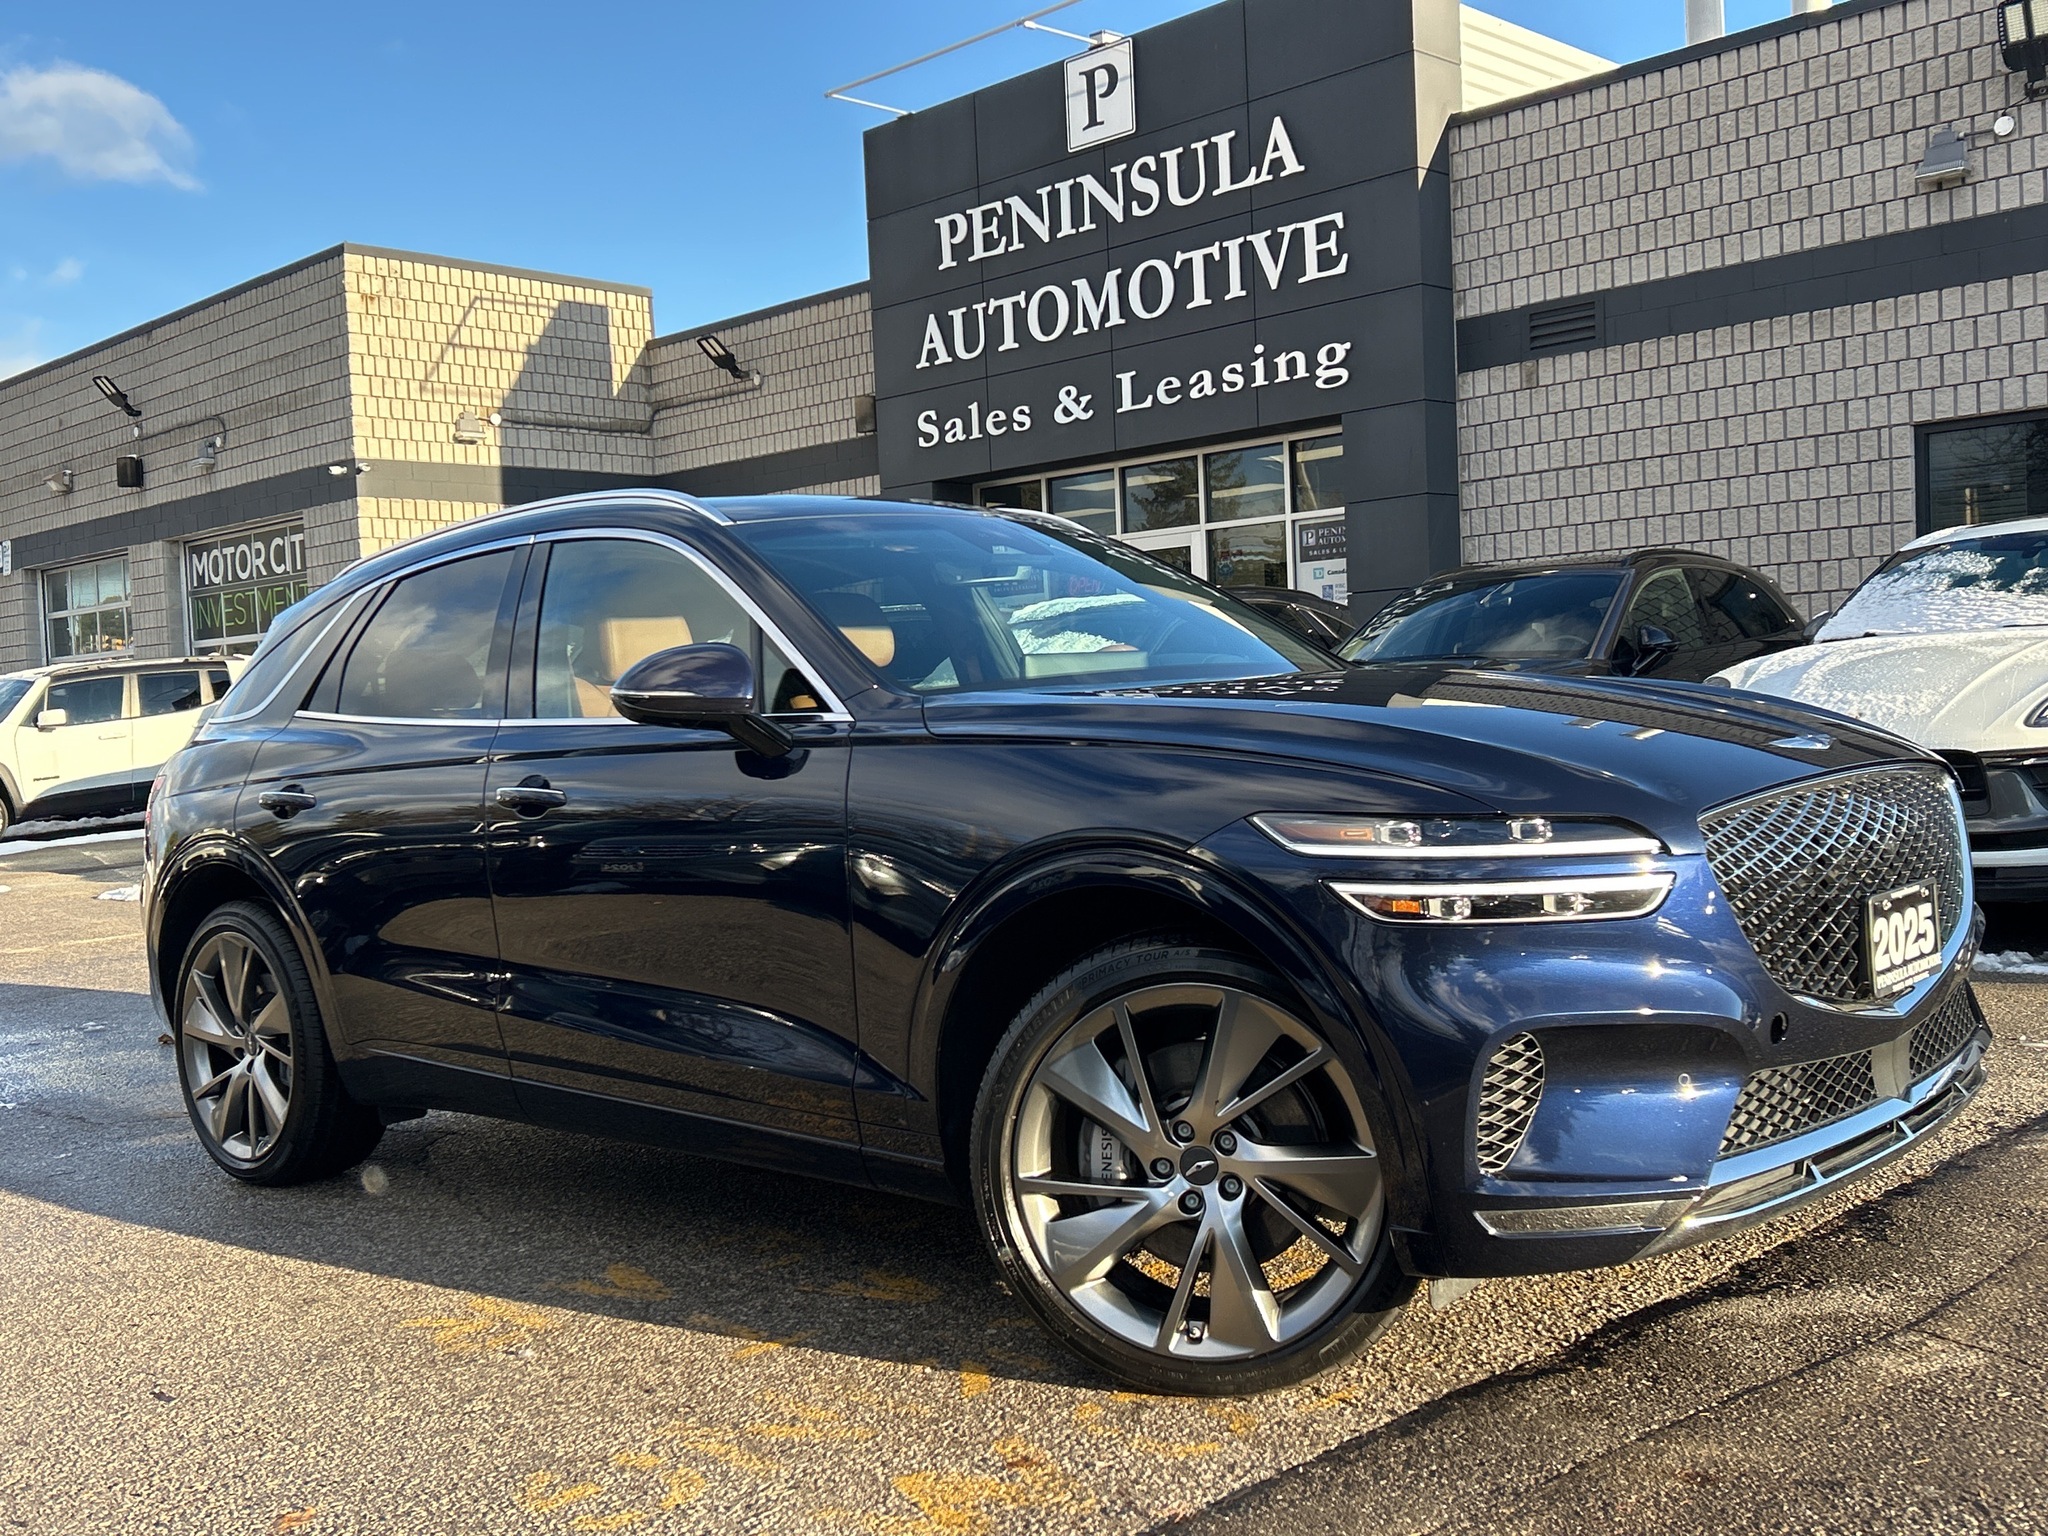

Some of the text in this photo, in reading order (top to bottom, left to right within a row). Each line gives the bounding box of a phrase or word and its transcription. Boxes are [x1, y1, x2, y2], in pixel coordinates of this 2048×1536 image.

[1078, 62, 1119, 132] P
[934, 115, 1305, 271] PENINSULA
[915, 211, 1349, 370] AUTOMOTIVE
[917, 340, 1352, 448] Sales & Leasing
[192, 533, 304, 587] MOTOR CIT
[1081, 959, 1131, 987] PRIMACY
[1136, 951, 1170, 964] TOUR
[1873, 902, 1935, 972] 2025
[1101, 1128, 1113, 1181] ENESIS
